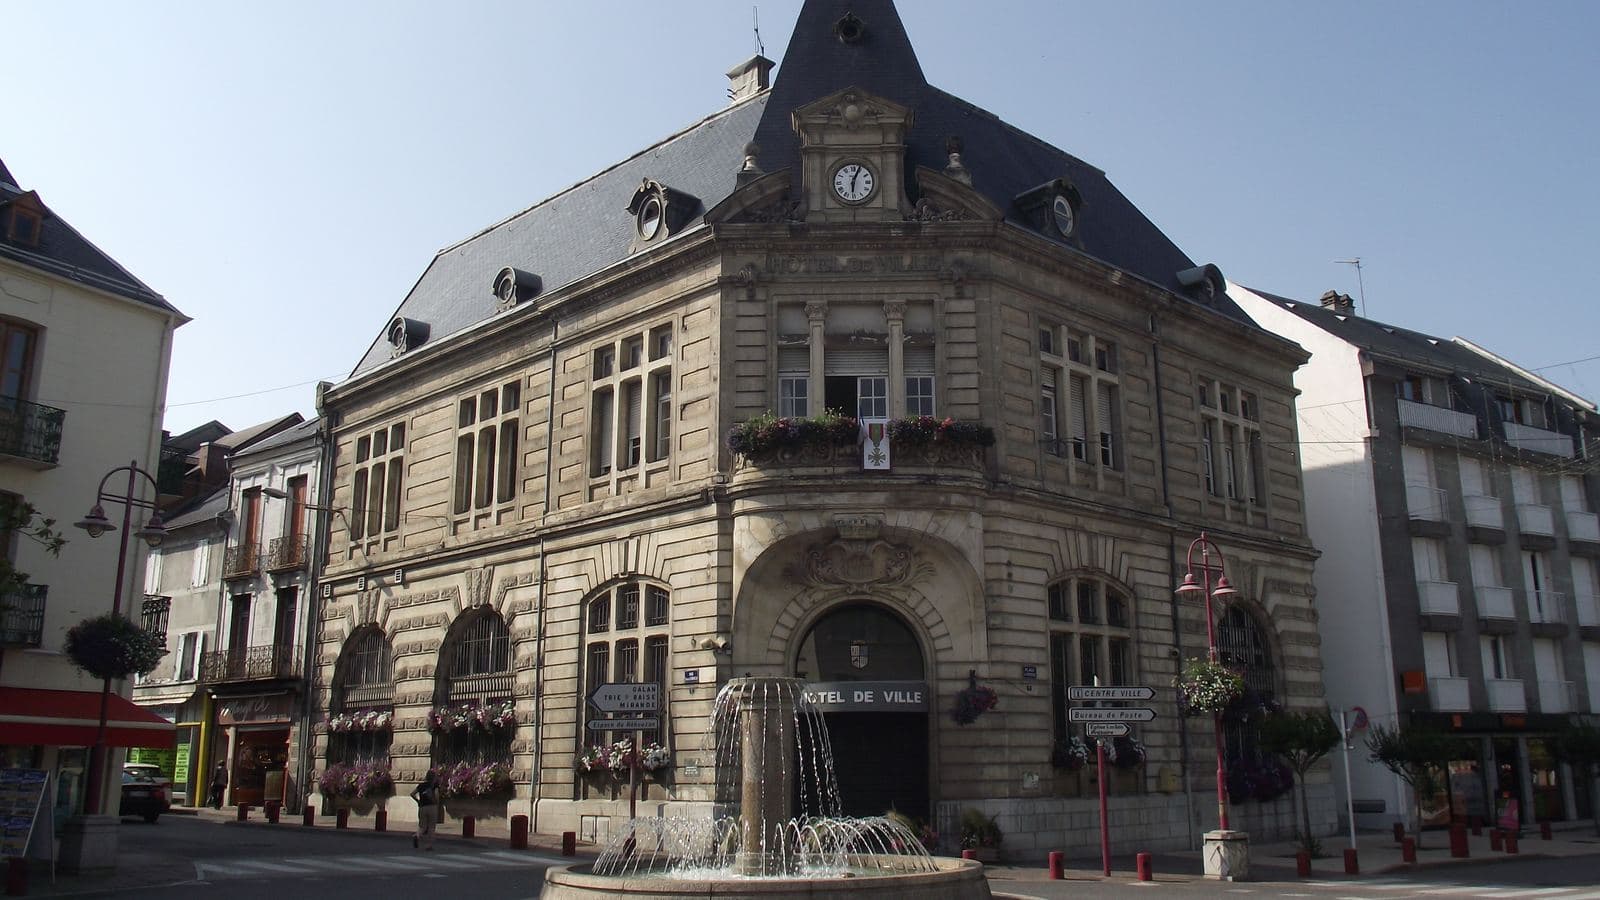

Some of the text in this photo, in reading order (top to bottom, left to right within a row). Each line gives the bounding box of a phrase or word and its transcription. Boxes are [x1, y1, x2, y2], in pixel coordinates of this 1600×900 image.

[853, 690, 874, 703] DE
[883, 690, 922, 703] VILLE
[1084, 689, 1116, 697] CENTRE
[1121, 689, 1142, 697] VILLE
[1074, 711, 1103, 719] Bureau
[1119, 711, 1143, 719] Poste
